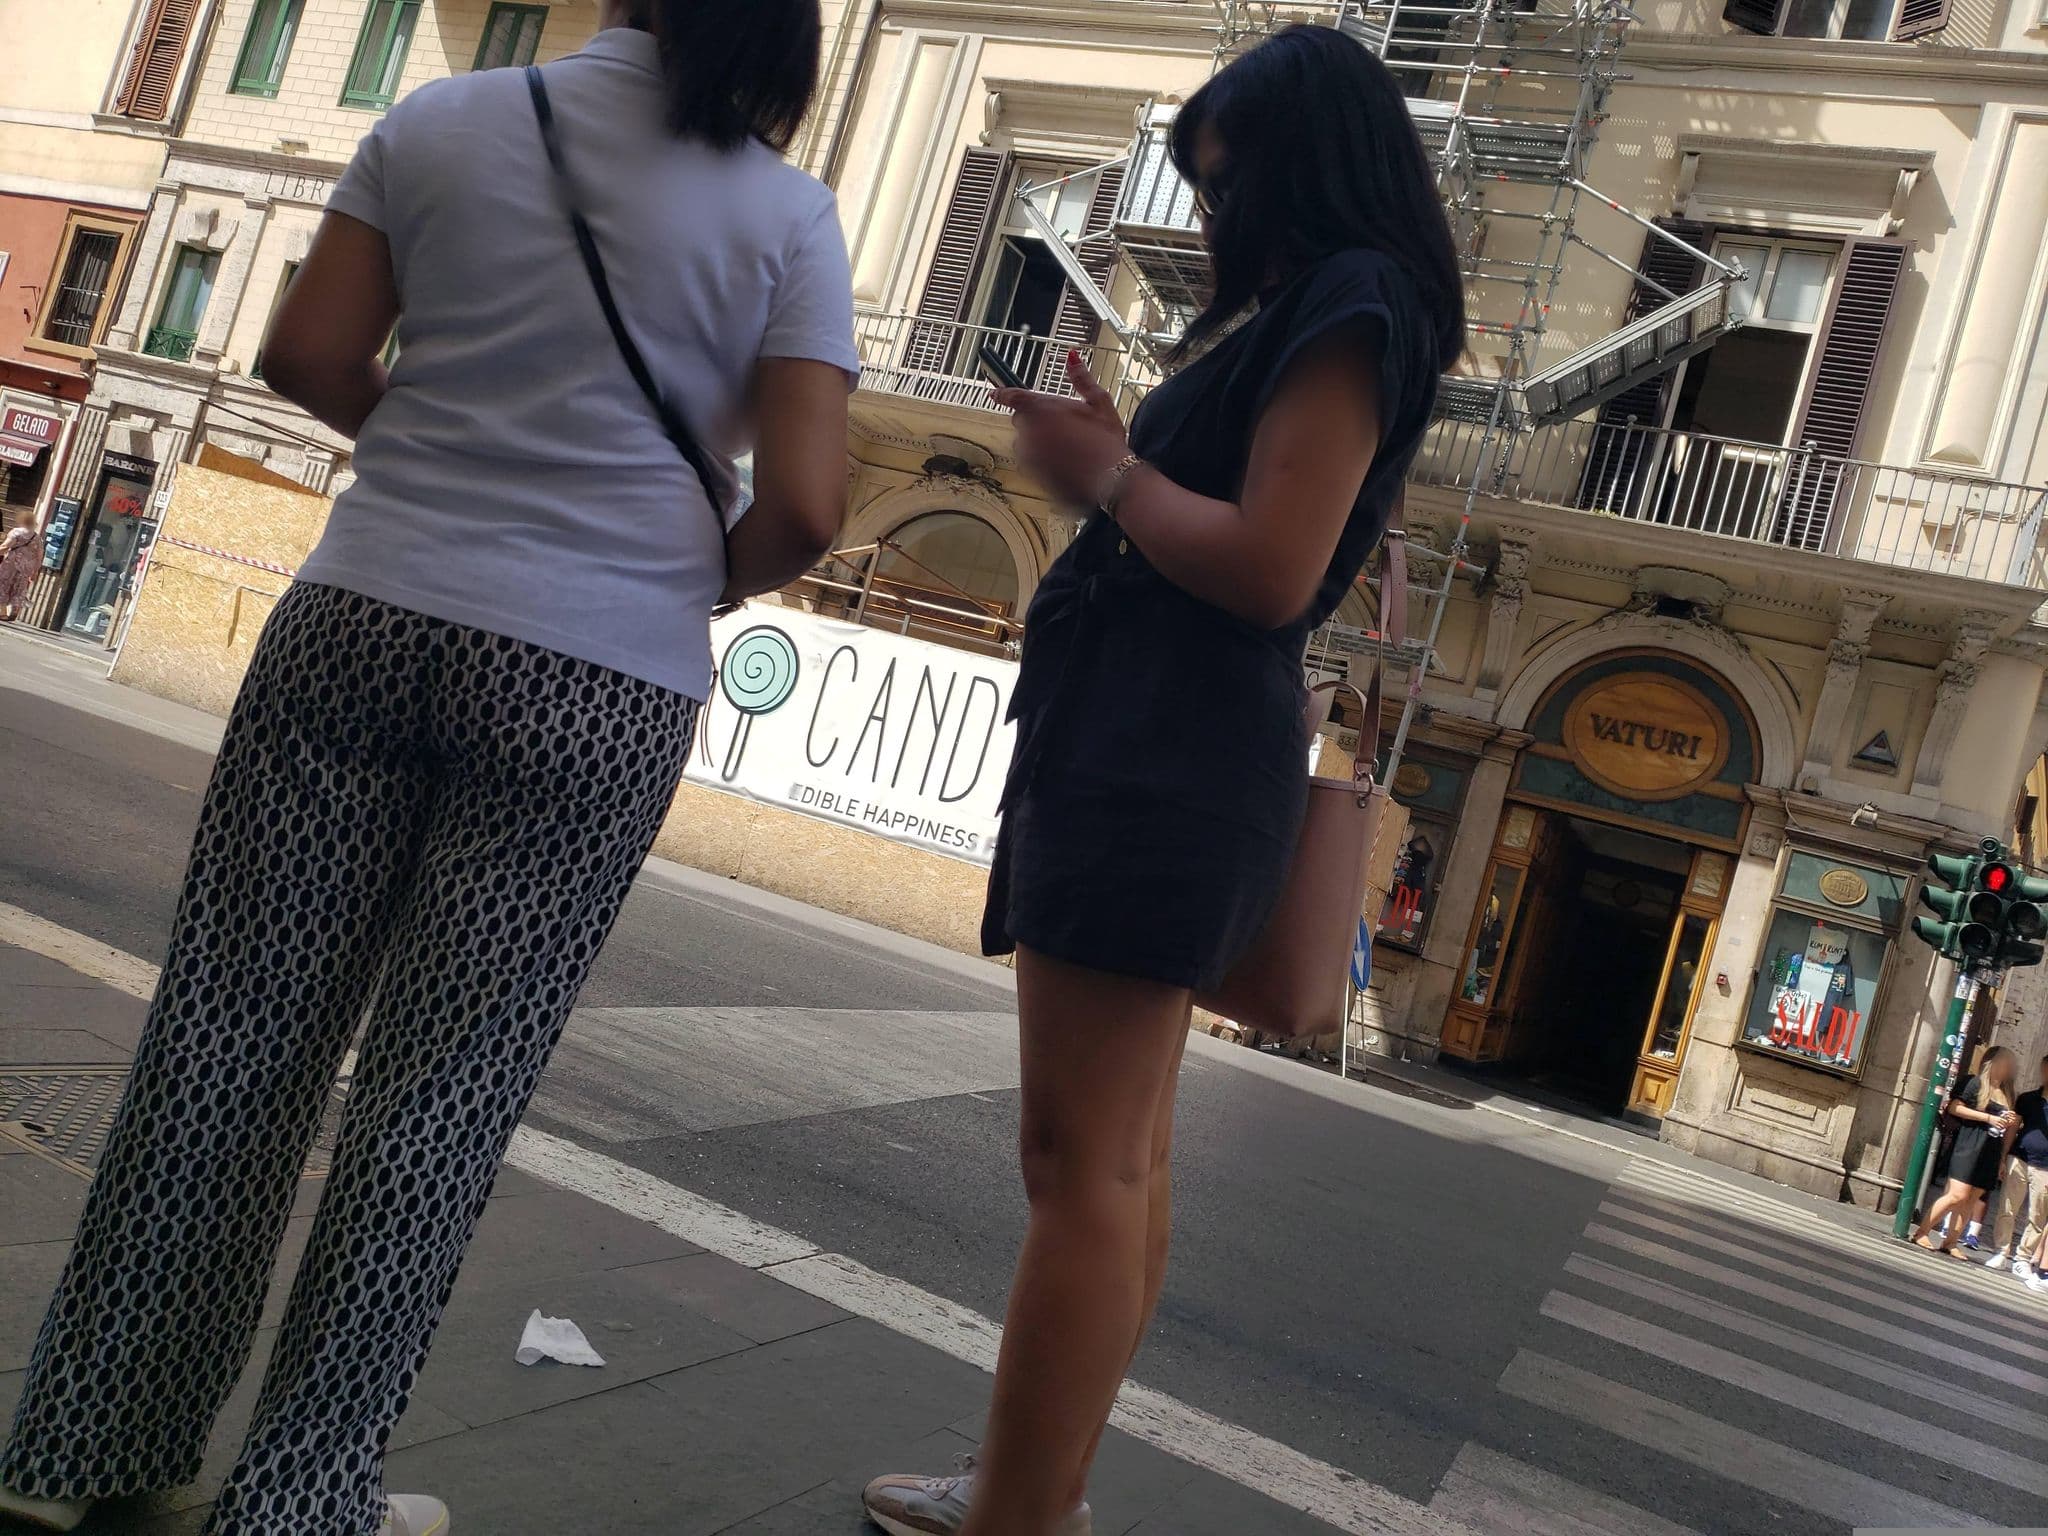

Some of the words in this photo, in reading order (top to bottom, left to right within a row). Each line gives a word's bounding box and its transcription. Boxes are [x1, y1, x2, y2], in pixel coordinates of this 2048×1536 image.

[12, 413, 49, 437] GELATO
[1590, 711, 1703, 760] VATURI
[863, 803, 979, 851] HAPPINESS
[1769, 992, 1861, 1060] SALDI
